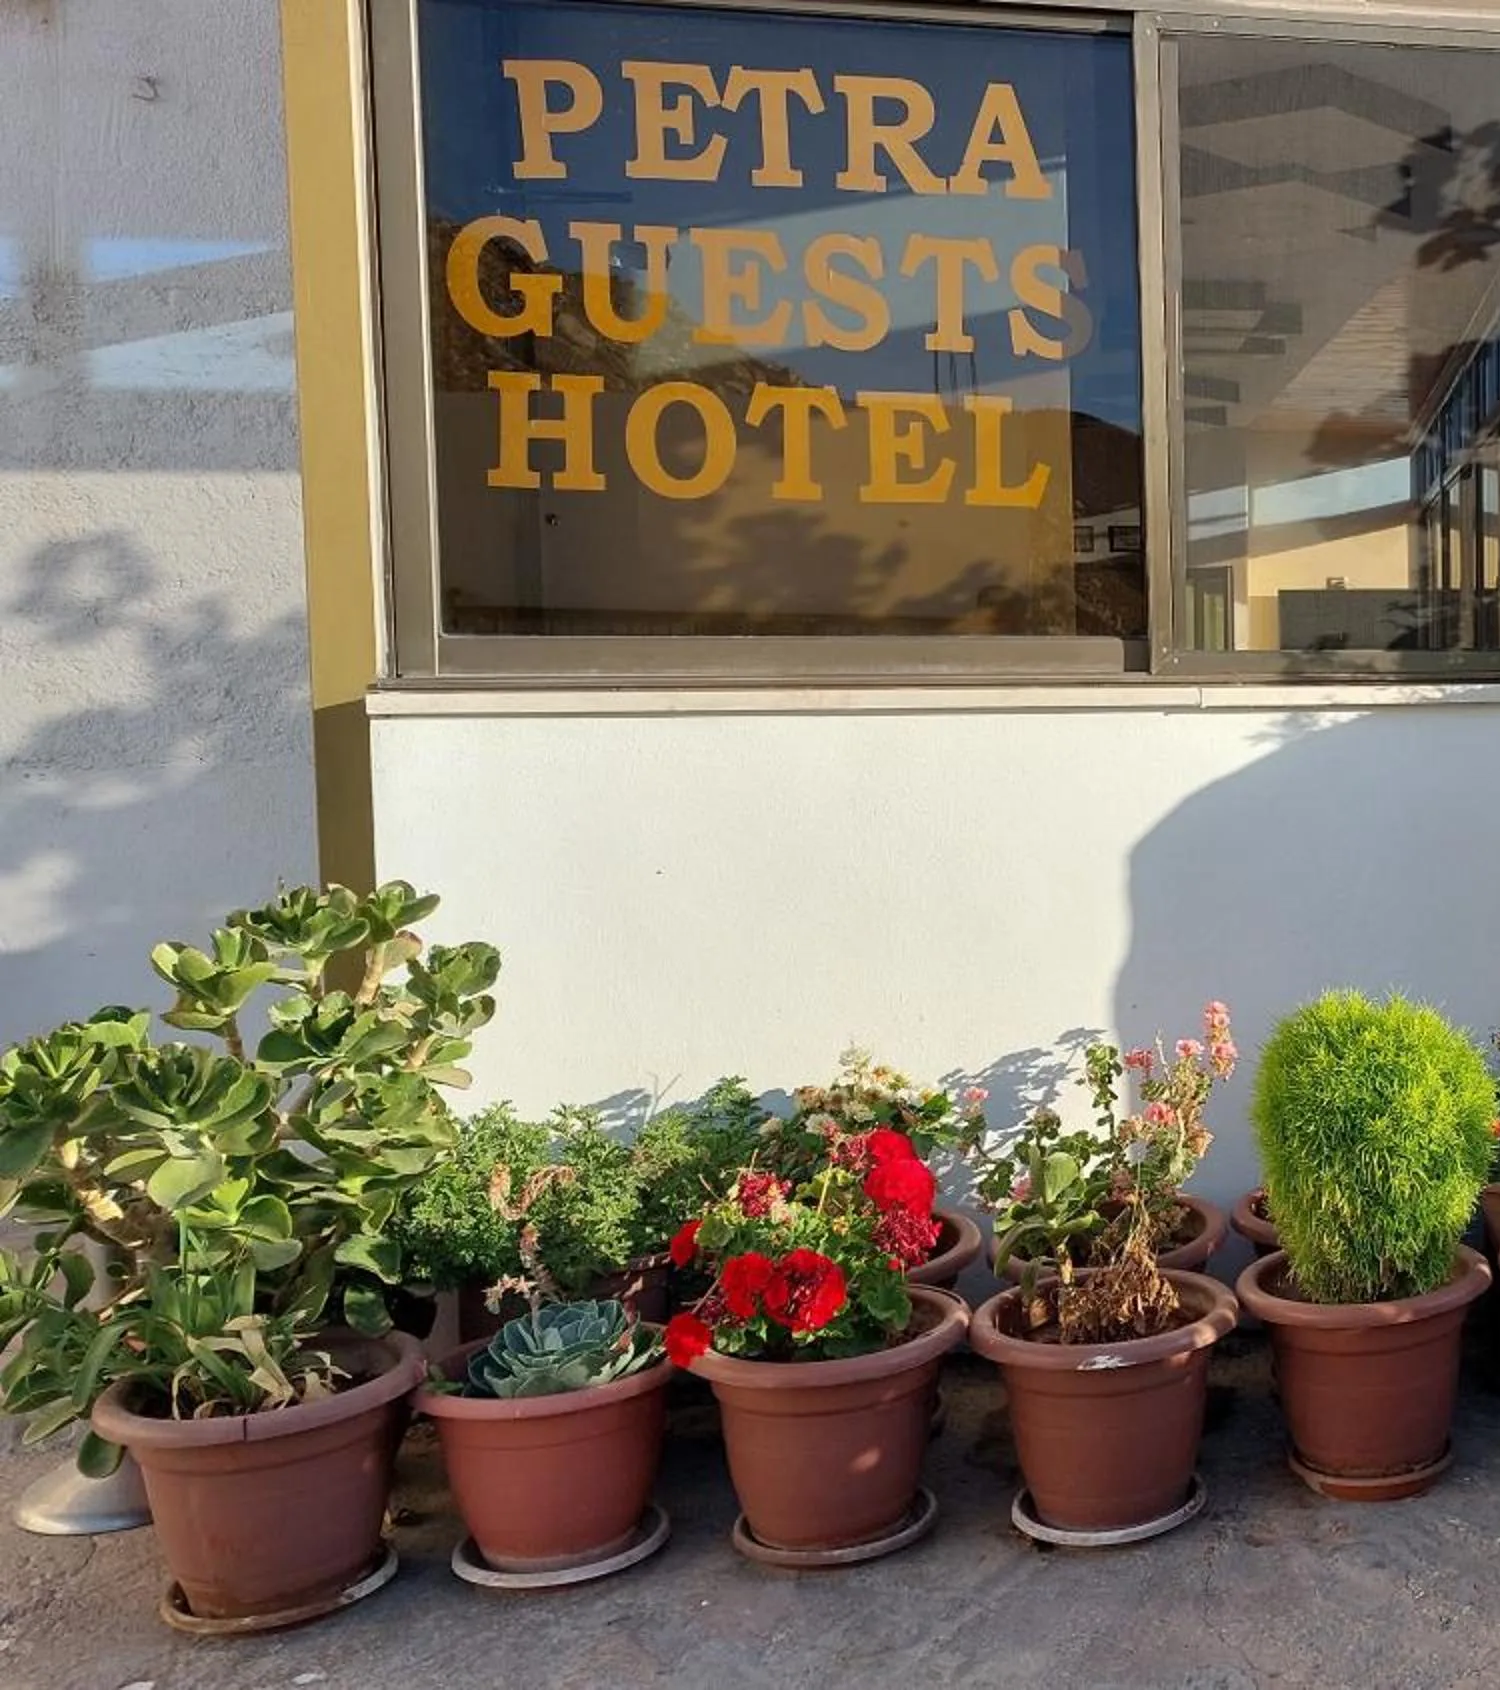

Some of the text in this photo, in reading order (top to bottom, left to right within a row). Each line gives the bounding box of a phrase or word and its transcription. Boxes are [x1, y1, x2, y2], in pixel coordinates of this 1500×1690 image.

[502, 59, 1053, 199] PETRA
[445, 214, 1093, 361] GUESTS
[487, 370, 1051, 510] HOTEL
